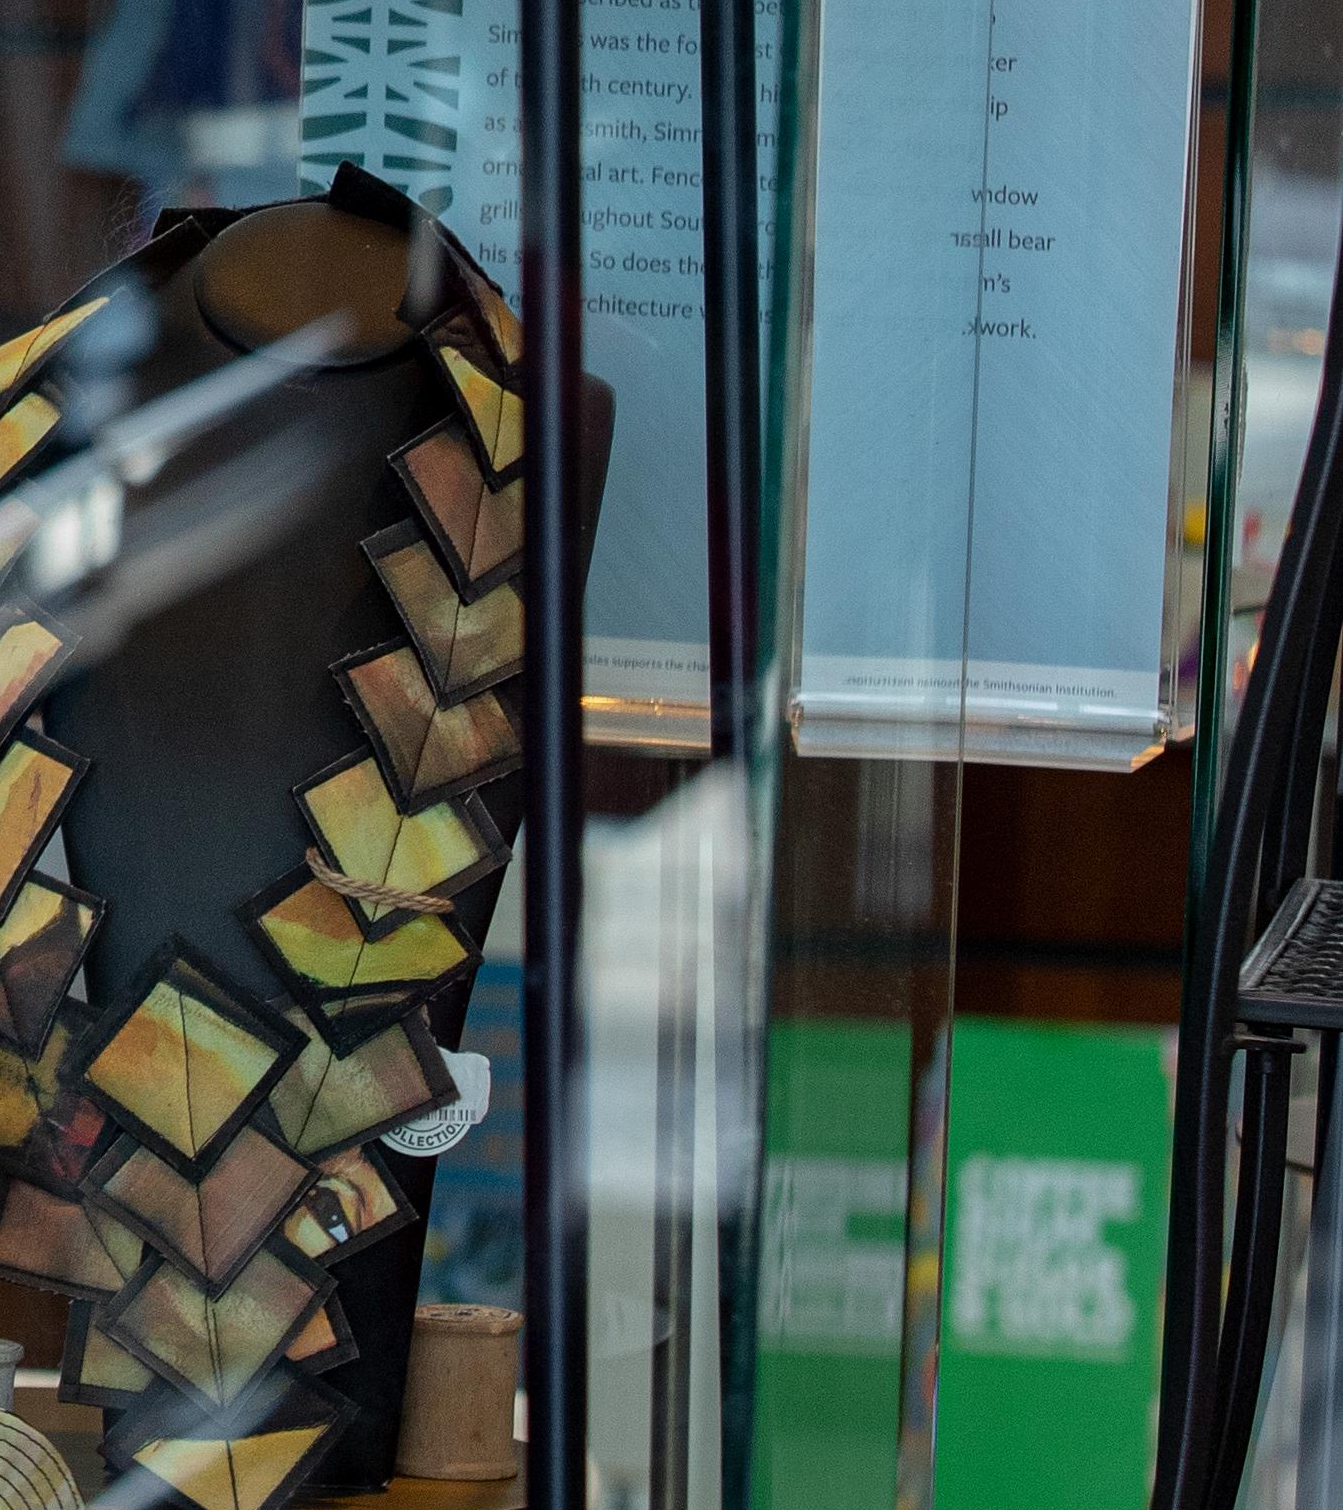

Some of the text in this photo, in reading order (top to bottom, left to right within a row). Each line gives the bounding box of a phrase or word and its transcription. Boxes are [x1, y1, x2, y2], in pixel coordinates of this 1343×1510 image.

[590, 34, 629, 51] was
[637, 33, 670, 53] the
[487, 68, 510, 87] of
[608, 78, 692, 104] century.
[485, 115, 506, 132] as
[609, 166, 644, 184] art.
[1010, 229, 1056, 251] bear
[479, 243, 507, 264] his
[589, 251, 616, 270] So
[622, 252, 671, 273] does
[983, 677, 1052, 694] Smithsonian
[1055, 684, 1117, 699] Institution.
